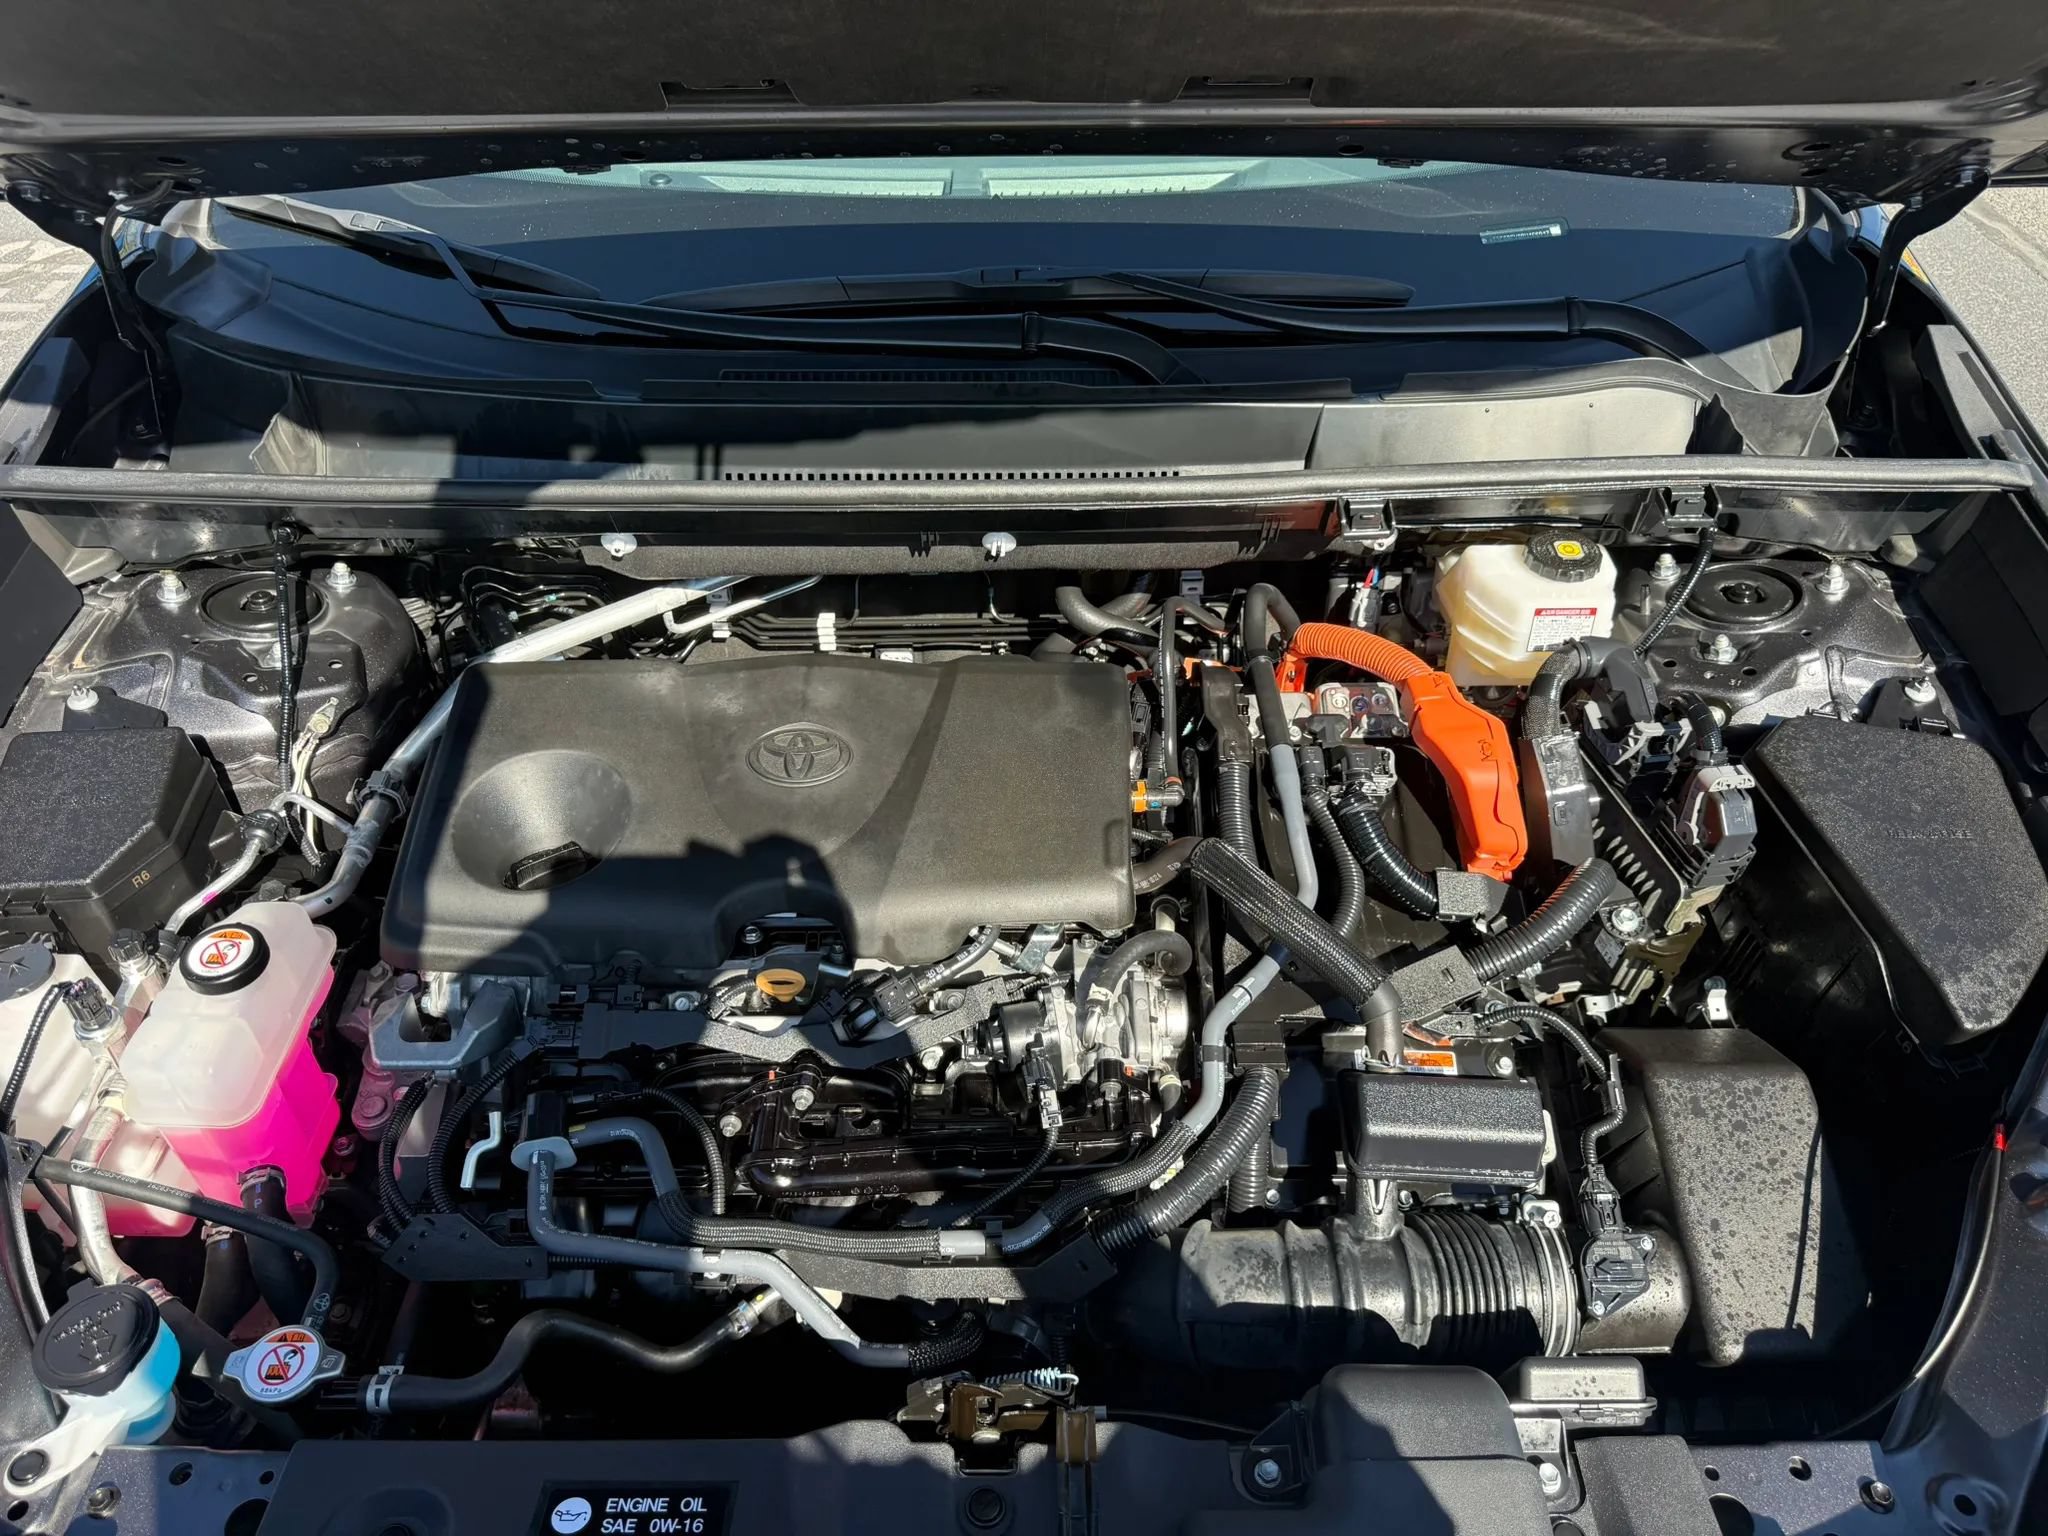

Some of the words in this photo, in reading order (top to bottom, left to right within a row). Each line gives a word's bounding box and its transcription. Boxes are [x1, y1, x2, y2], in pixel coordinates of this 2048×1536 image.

[131, 870, 151, 888] R6
[605, 1497, 670, 1513] ENGINE
[680, 1497, 708, 1513] OIL
[600, 1518, 638, 1534] SAE
[649, 1518, 704, 1534] 0W-16
